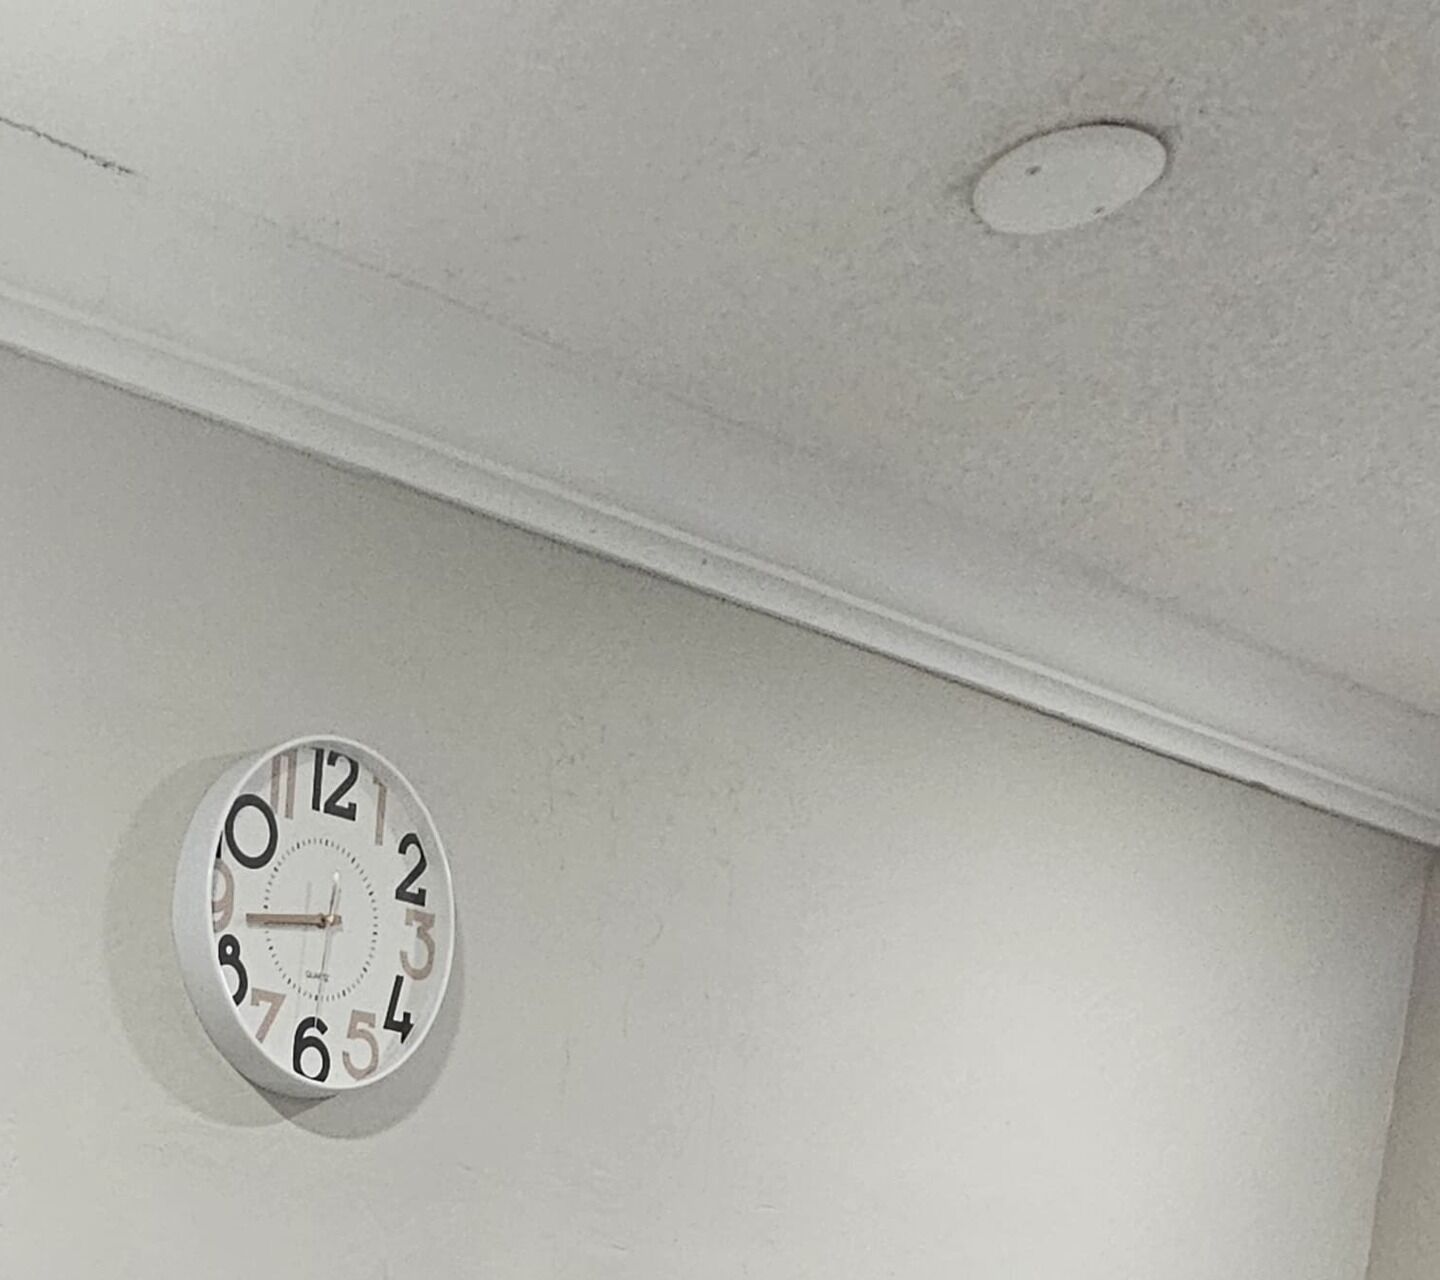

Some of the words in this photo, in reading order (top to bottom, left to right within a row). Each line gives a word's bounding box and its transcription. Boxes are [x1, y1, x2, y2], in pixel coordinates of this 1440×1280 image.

[270, 749, 298, 820] 11
[310, 747, 359, 822] 12
[371, 775, 388, 846] 1
[215, 792, 278, 870] 0
[395, 832, 427, 907] 2
[218, 934, 248, 1007] 8
[399, 908, 436, 981] 3
[250, 987, 287, 1044] 7
[342, 1009, 379, 1081] 5
[383, 974, 415, 1044] 4
[293, 1016, 331, 1083] 6
